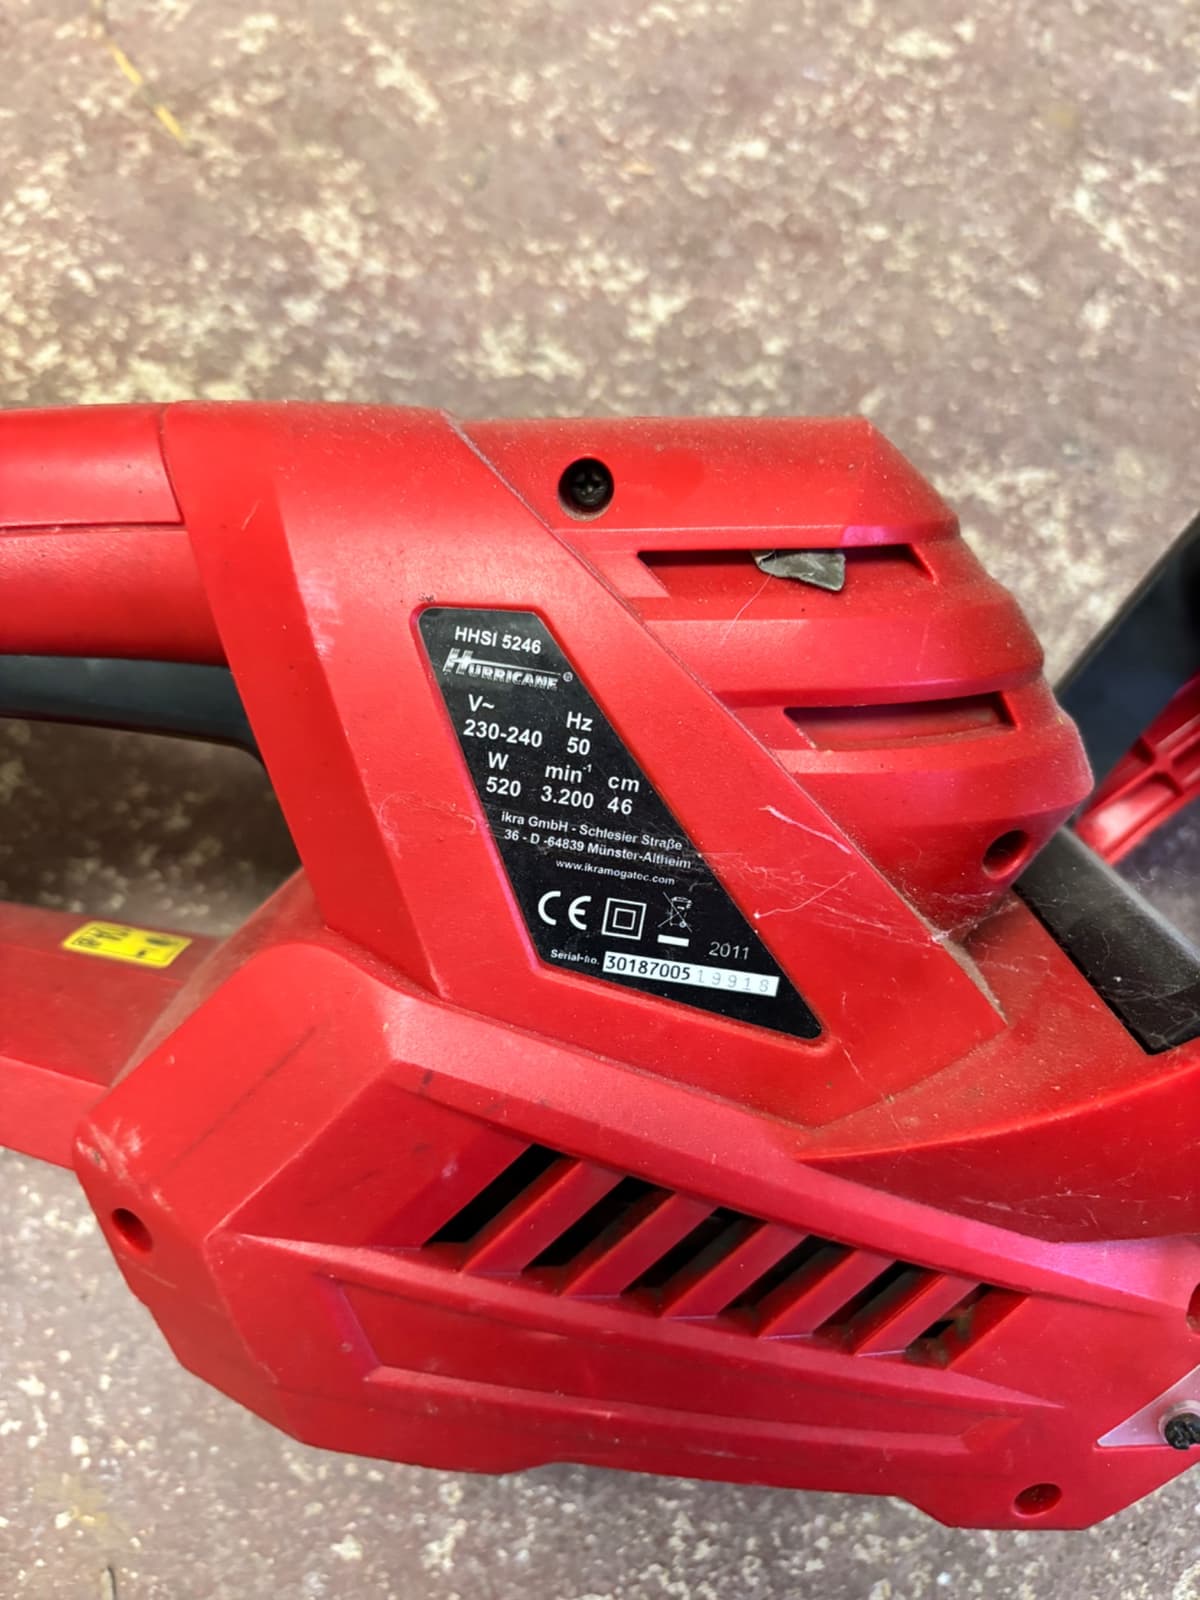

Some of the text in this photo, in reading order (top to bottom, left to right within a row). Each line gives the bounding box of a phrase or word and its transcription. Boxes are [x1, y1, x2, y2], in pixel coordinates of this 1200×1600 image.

[454, 625, 542, 655] HHSI 5246
[463, 719, 591, 756] 230-240 50
[566, 711, 593, 732] Hz
[488, 752, 509, 770] W
[608, 776, 640, 793] cm
[486, 777, 633, 815] 520 3.200 46
[501, 811, 525, 826] ikra
[528, 816, 569, 833] GmbH
[579, 823, 638, 844] Schlesier
[504, 829, 519, 842] 36
[530, 833, 541, 845] D
[587, 841, 692, 870] Münster-Altheim
[555, 859, 675, 885] www.ikramogatec.com
[708, 941, 750, 961] 2011
